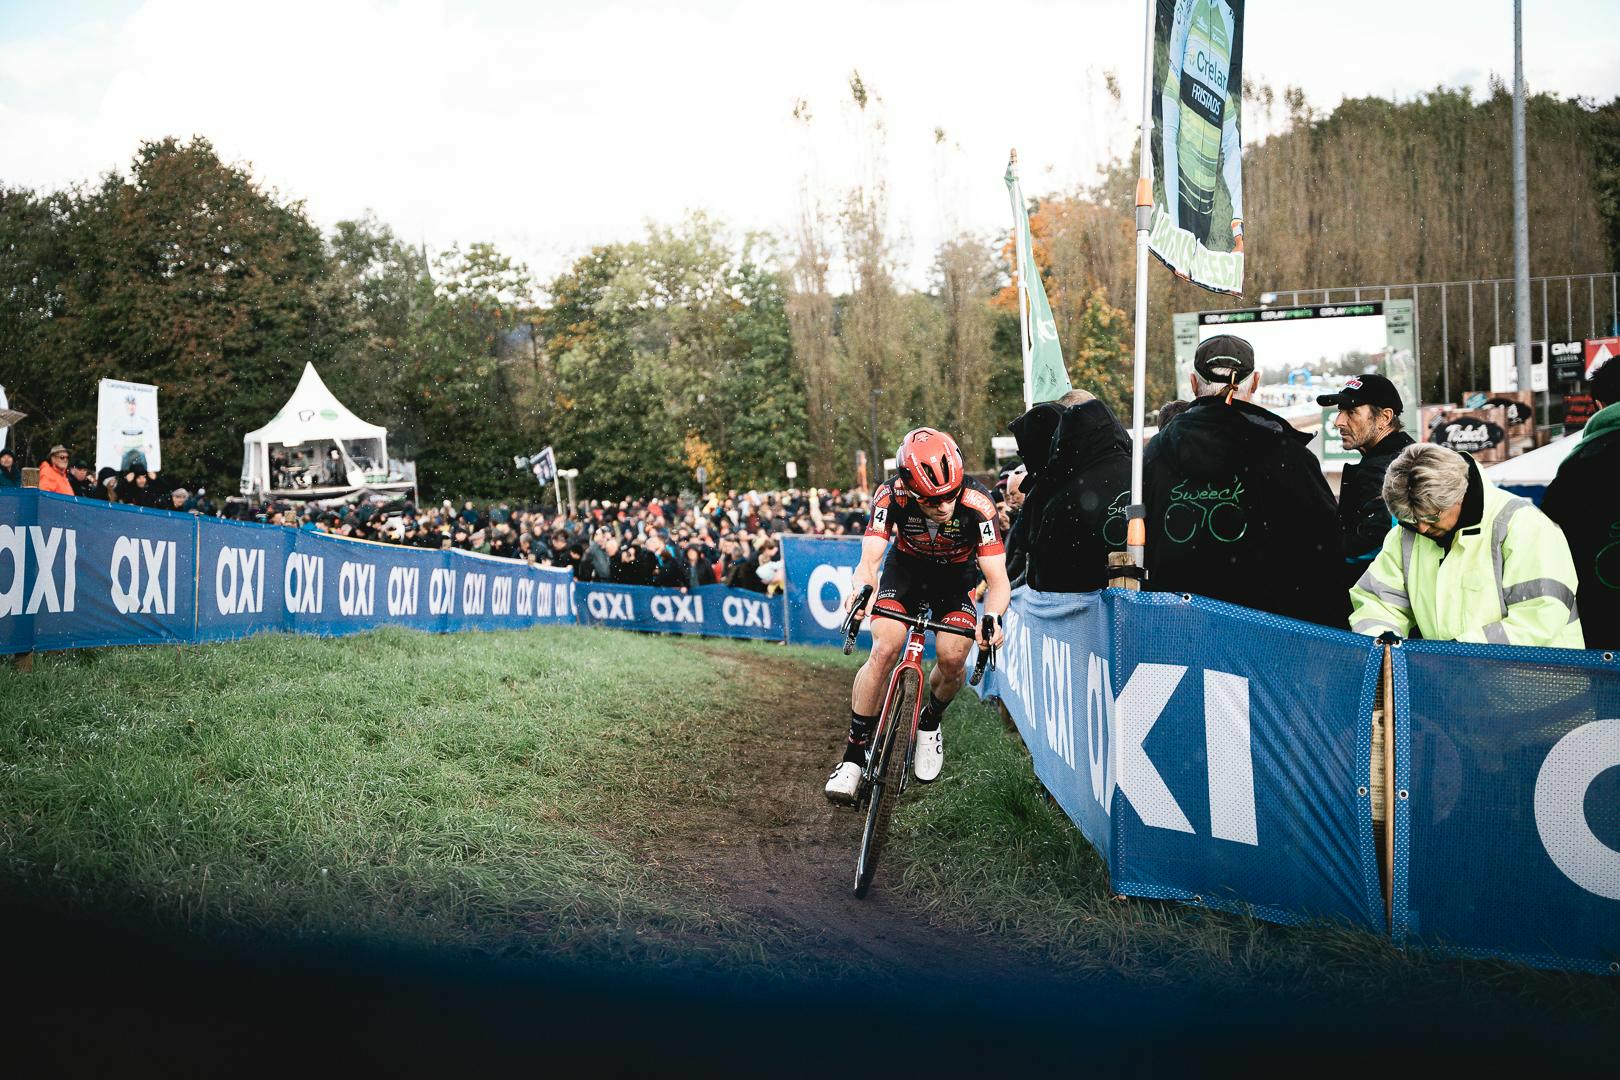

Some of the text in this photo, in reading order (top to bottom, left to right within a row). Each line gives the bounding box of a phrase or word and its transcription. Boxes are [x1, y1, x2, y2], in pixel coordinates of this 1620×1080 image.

[1191, 83, 1221, 116] FRISTADS
[875, 510, 884, 523] 4
[983, 523, 992, 537] 4
